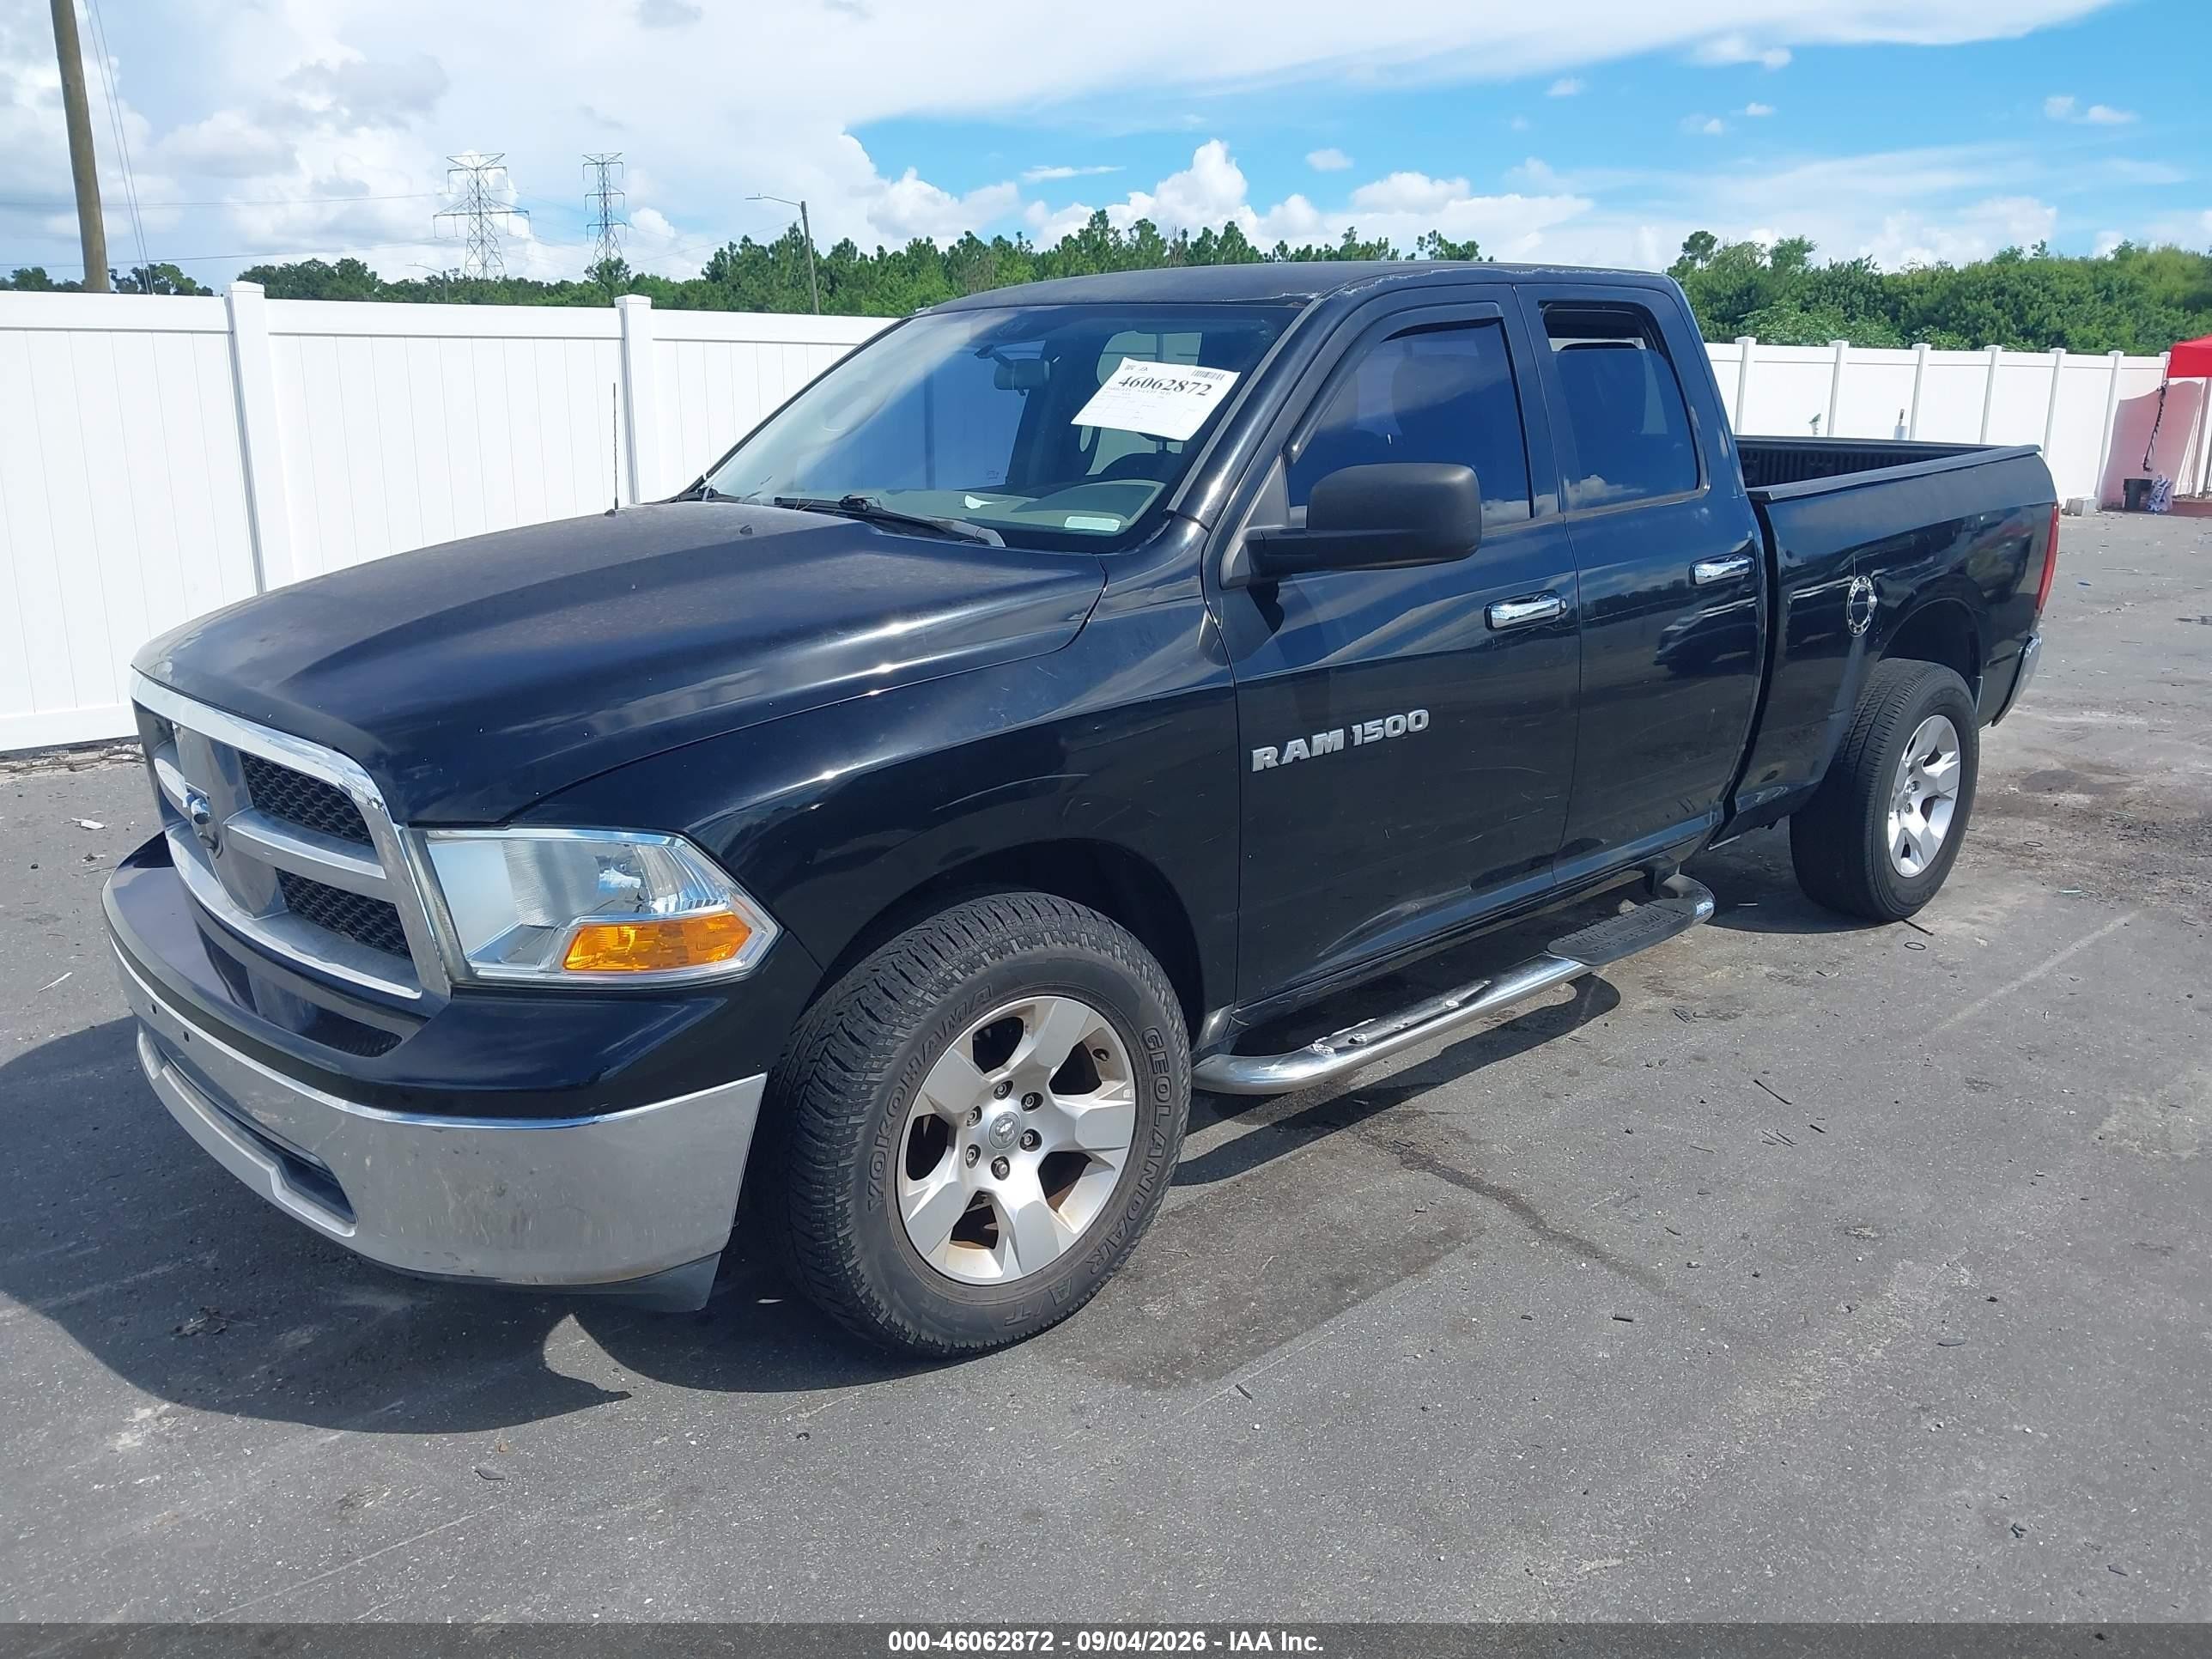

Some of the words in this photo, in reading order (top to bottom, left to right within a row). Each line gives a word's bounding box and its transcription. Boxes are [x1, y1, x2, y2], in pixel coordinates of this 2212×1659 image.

[1118, 375, 1212, 397] 46062872
[1251, 727, 1345, 772] RAM
[1351, 708, 1430, 746] 1500
[867, 983, 994, 1212] YOKOHAMA
[1085, 1026, 1172, 1275] GEOLANDAR
